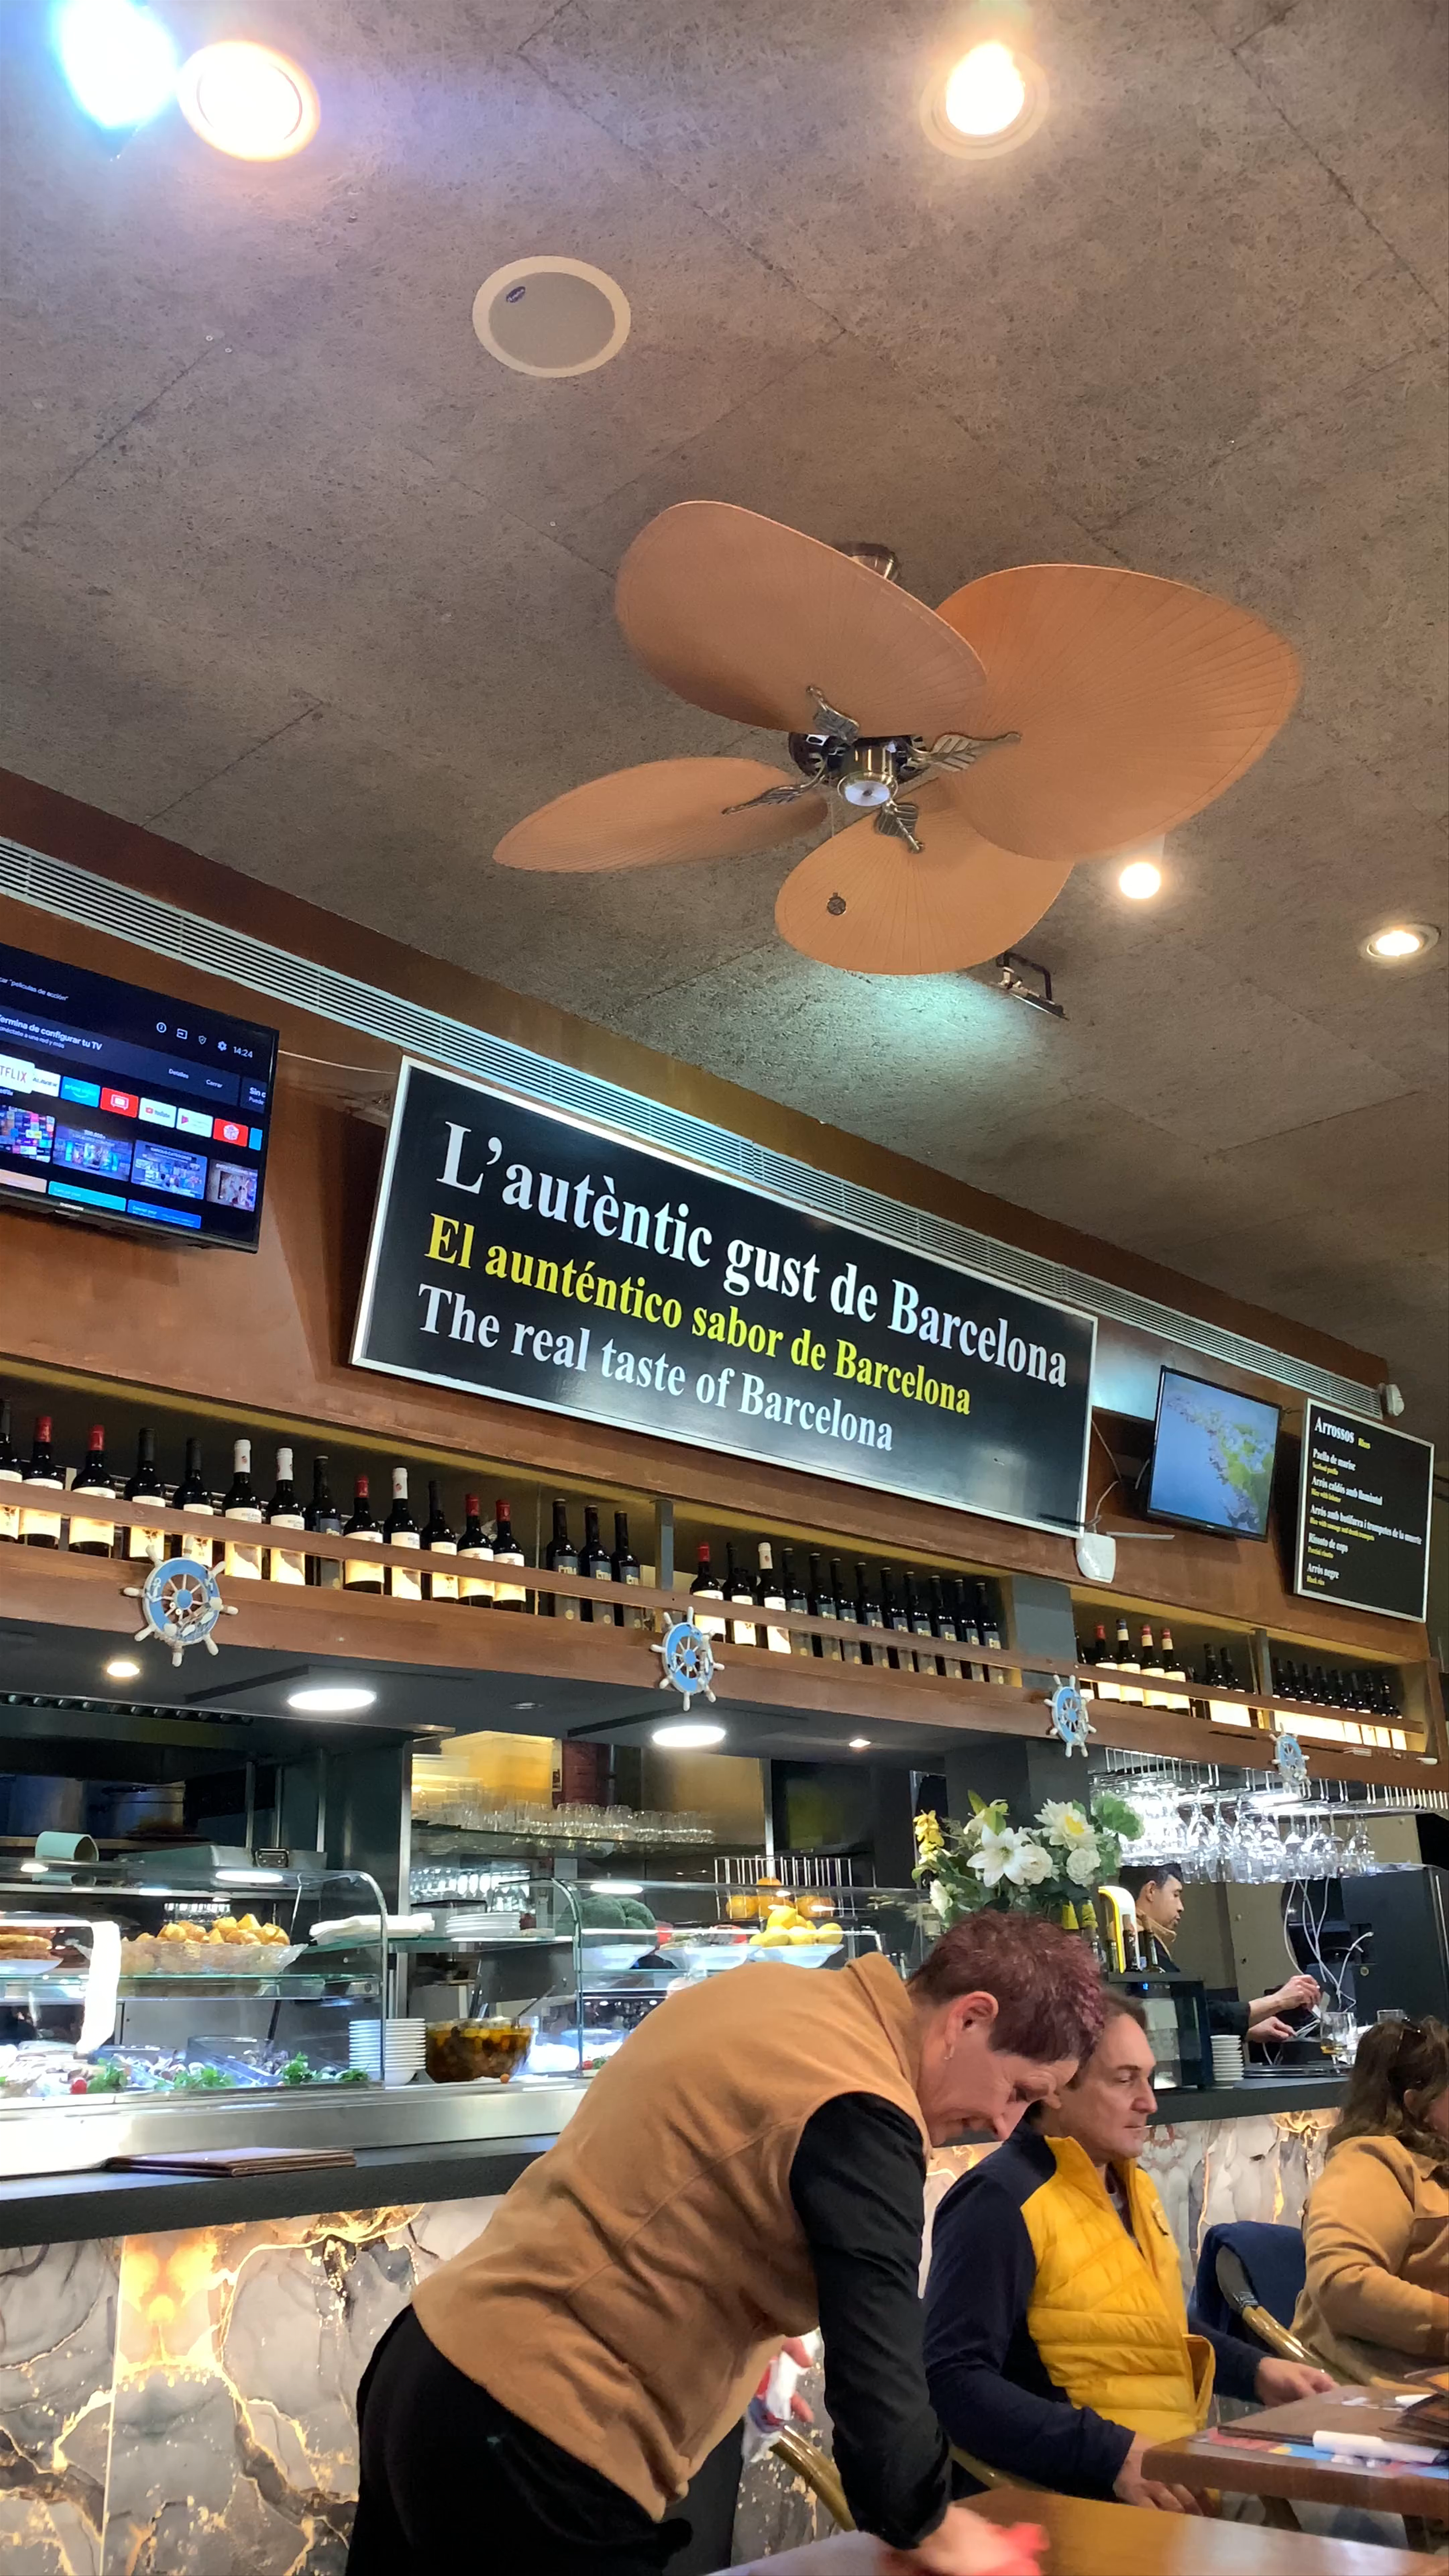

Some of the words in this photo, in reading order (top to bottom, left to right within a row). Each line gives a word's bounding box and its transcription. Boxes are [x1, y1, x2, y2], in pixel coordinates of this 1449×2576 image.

[0, 1026, 23, 1037] onéctate
[29, 1024, 40, 1033] de
[41, 1028, 81, 1044] configurar
[92, 1041, 103, 1050] TV
[233, 1046, 253, 1058] 14:24
[0, 1065, 27, 1083] TFLIX
[206, 1079, 223, 1088] Cerrar
[249, 1087, 260, 1096] Sin
[424, 1213, 475, 1269] El
[485, 1245, 682, 1328] aunténtico
[692, 1306, 783, 1358] sabor
[791, 1328, 826, 1371] de
[833, 1339, 971, 1415] Barcelona
[723, 1239, 820, 1303] gust
[831, 1263, 878, 1322] de
[888, 1279, 1067, 1387] Barcelona
[418, 1284, 500, 1347] The
[511, 1327, 589, 1372] real
[601, 1338, 685, 1396] taste
[696, 1368, 734, 1408] of
[738, 1372, 893, 1451] Barcelona
[1314, 1416, 1355, 1444] Arrossos
[1330, 1454, 1337, 1464] de
[1364, 1519, 1367, 1528] i
[1392, 1528, 1398, 1538] de
[1399, 1530, 1404, 1539] la
[1329, 1538, 1336, 1549] de
